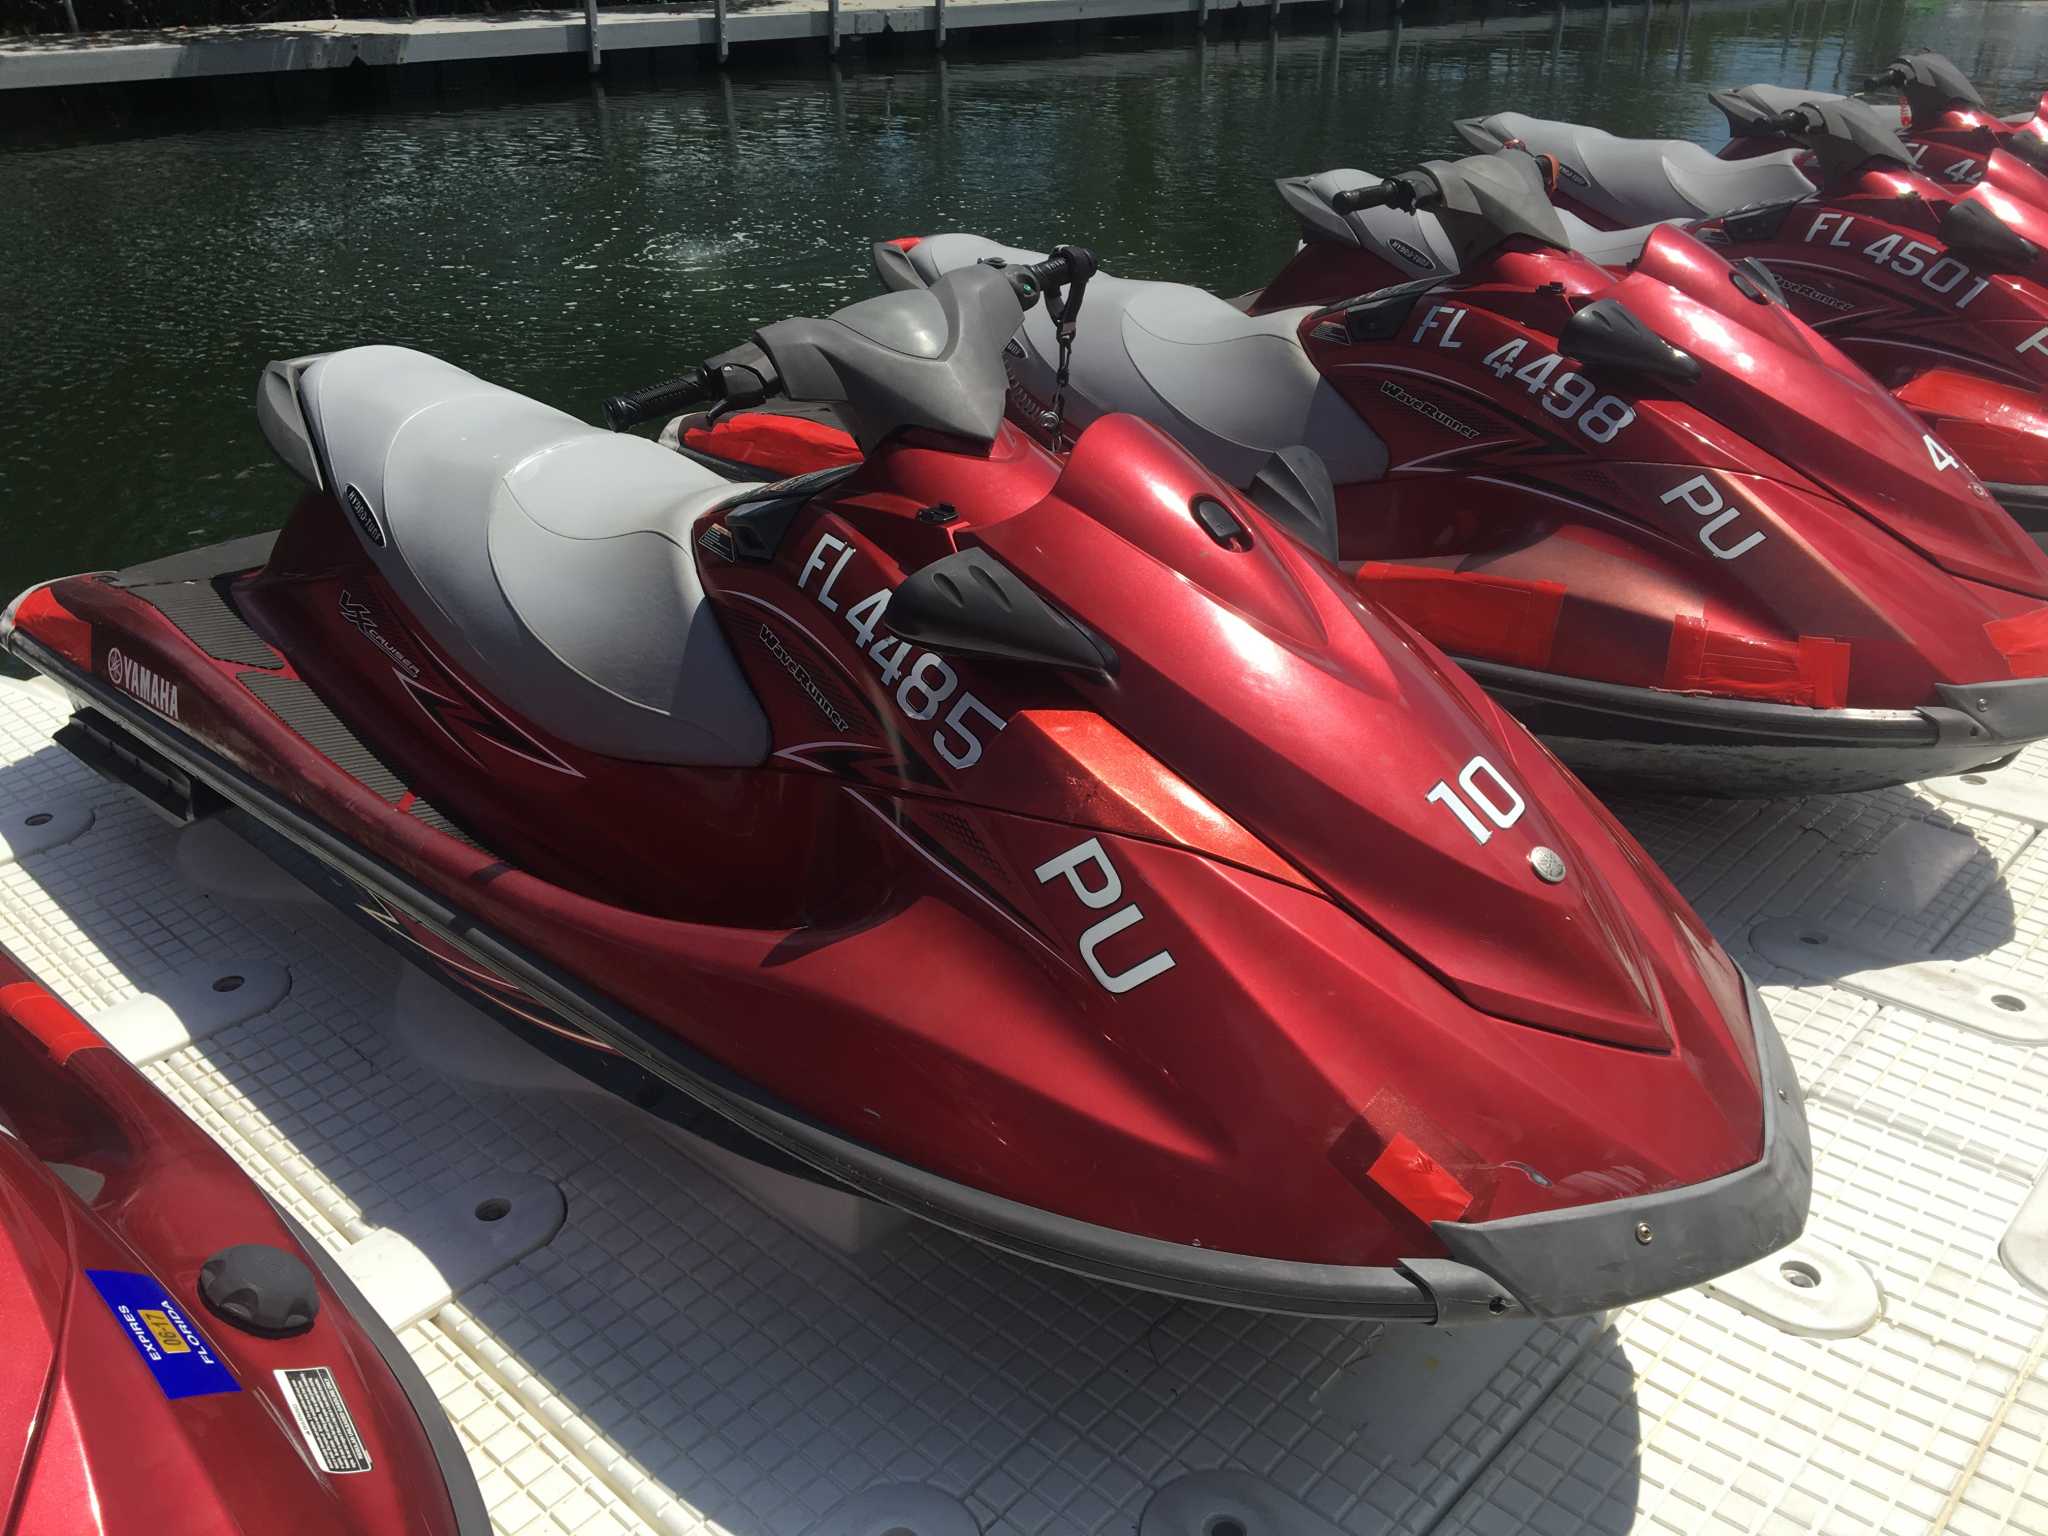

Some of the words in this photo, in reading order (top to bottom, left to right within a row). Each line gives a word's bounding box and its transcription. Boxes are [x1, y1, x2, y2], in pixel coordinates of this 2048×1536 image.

[1805, 213, 1854, 247] FL
[1863, 234, 1989, 308] 4501
[1380, 381, 1480, 439] WaveRunner
[1412, 306, 1469, 348] FL
[1482, 338, 1637, 443] 4498
[1923, 434, 1959, 471] 4
[1660, 474, 1767, 560] PU
[124, 656, 179, 720] YAMAHA
[759, 624, 848, 732] WaveRunner
[797, 533, 856, 612] FL
[845, 588, 1007, 769] 4485
[1426, 755, 1526, 845] 10
[1034, 837, 1176, 993] PU
[118, 1305, 162, 1360] EXPIRES
[145, 1313, 181, 1347] 06-17
[161, 1301, 214, 1364] FLORIDA
